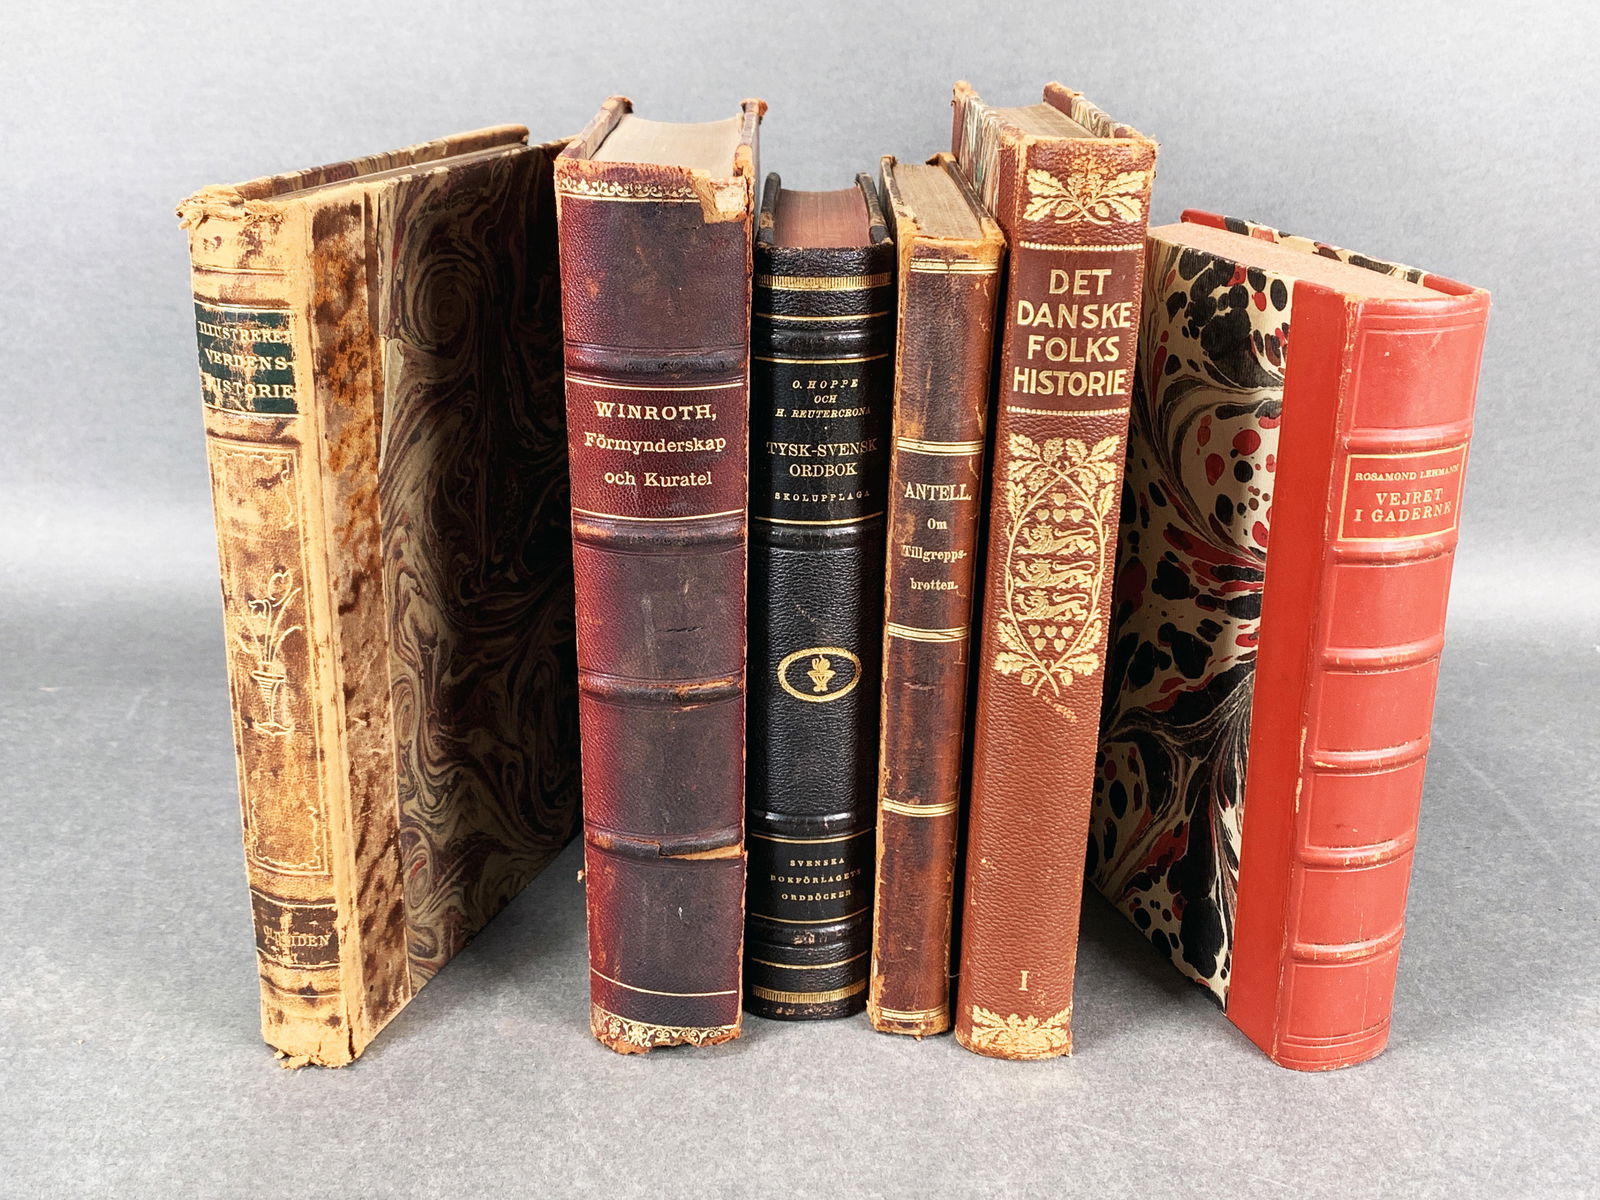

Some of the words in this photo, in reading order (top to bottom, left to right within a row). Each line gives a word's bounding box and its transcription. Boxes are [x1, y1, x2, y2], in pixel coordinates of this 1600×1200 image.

[1049, 268, 1112, 296] DET
[1017, 300, 1133, 329] DANSKE
[1027, 335, 1120, 363] FOLKS
[204, 349, 294, 370] VERDENS-
[792, 380, 803, 389] O.
[807, 378, 859, 389] HOPPE
[1012, 366, 1127, 397] HISTORIE
[814, 394, 838, 403] OCH
[594, 401, 717, 421] WINROTH,
[775, 408, 787, 417] H.
[584, 432, 726, 455] Förmynderskap
[766, 438, 878, 457] TYSK-SVENSK
[789, 462, 858, 478] ORDBOK
[1354, 472, 1417, 481] ROSAMOND
[1420, 464, 1460, 479] LEHMANN
[604, 472, 637, 486] och
[644, 472, 712, 487] Kuratel
[774, 491, 870, 502] SKOLUPPLAGA
[1375, 488, 1444, 506] VEJRET
[1353, 509, 1363, 522] I
[1371, 501, 1453, 523] GADERNE
[927, 517, 948, 530] Om
[902, 544, 968, 564] Tillgrepps-
[909, 577, 959, 591] brotten.
[790, 858, 845, 867] SVENSKA
[781, 889, 852, 901] ORDBÖCKER
[1018, 970, 1030, 991] I
